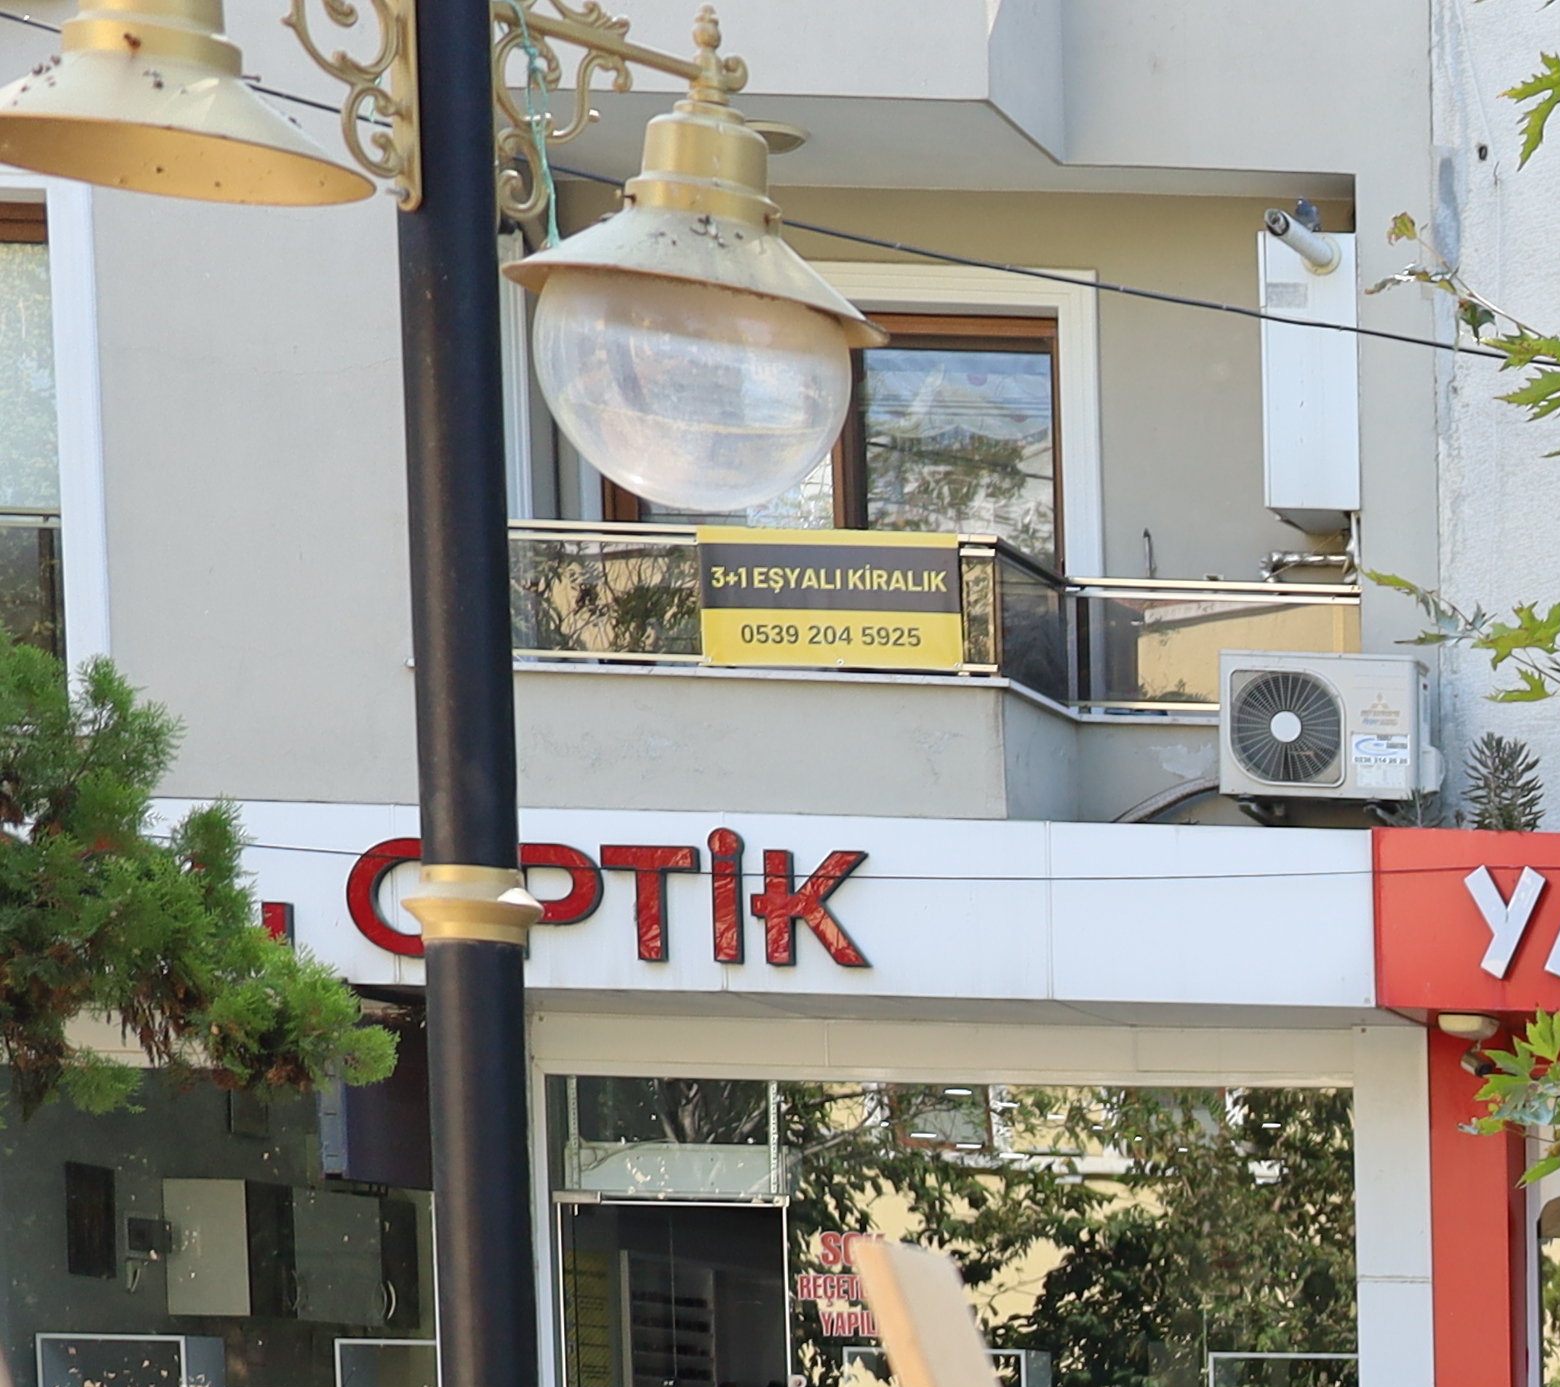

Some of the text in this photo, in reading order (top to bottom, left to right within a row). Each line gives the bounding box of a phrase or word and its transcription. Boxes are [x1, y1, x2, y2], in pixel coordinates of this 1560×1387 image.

[710, 564, 948, 593] 3+1 EŞYALI KİRALIK
[741, 624, 922, 647] 0539 204 5925
